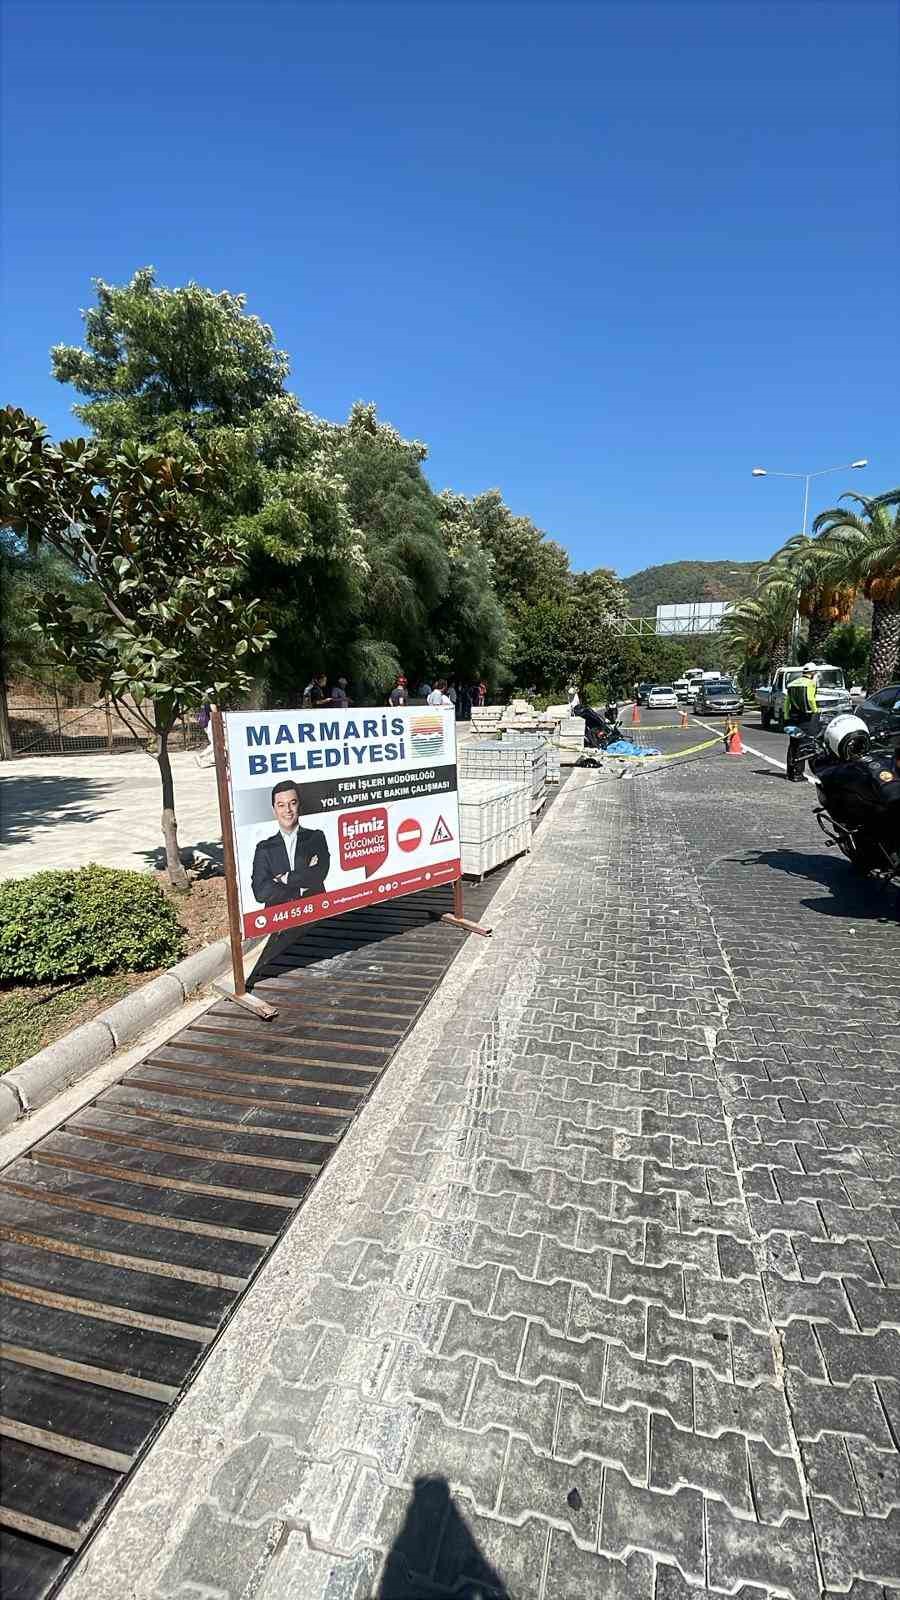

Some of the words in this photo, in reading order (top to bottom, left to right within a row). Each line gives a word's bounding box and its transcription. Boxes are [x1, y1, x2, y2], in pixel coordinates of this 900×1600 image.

[246, 714, 405, 746] MARMARİS
[248, 738, 406, 775] BELEDİYESİ
[338, 782, 356, 792] FEN
[358, 776, 385, 790] İŞLERİ
[387, 770, 435, 785] MÜDÜRLÜĞÜ
[320, 796, 339, 808] YOL
[341, 793, 368, 804] YAPIM
[370, 790, 382, 799] VE
[383, 786, 410, 797] BAKIM
[411, 781, 450, 795] ÇALIŞMASI
[343, 816, 385, 839] işimiz
[343, 834, 385, 851] GÜCÜMÜZ
[344, 843, 385, 860] MARMARİS
[272, 910, 289, 923] 444
[290, 907, 302, 918] 55
[303, 903, 314, 915] 48
